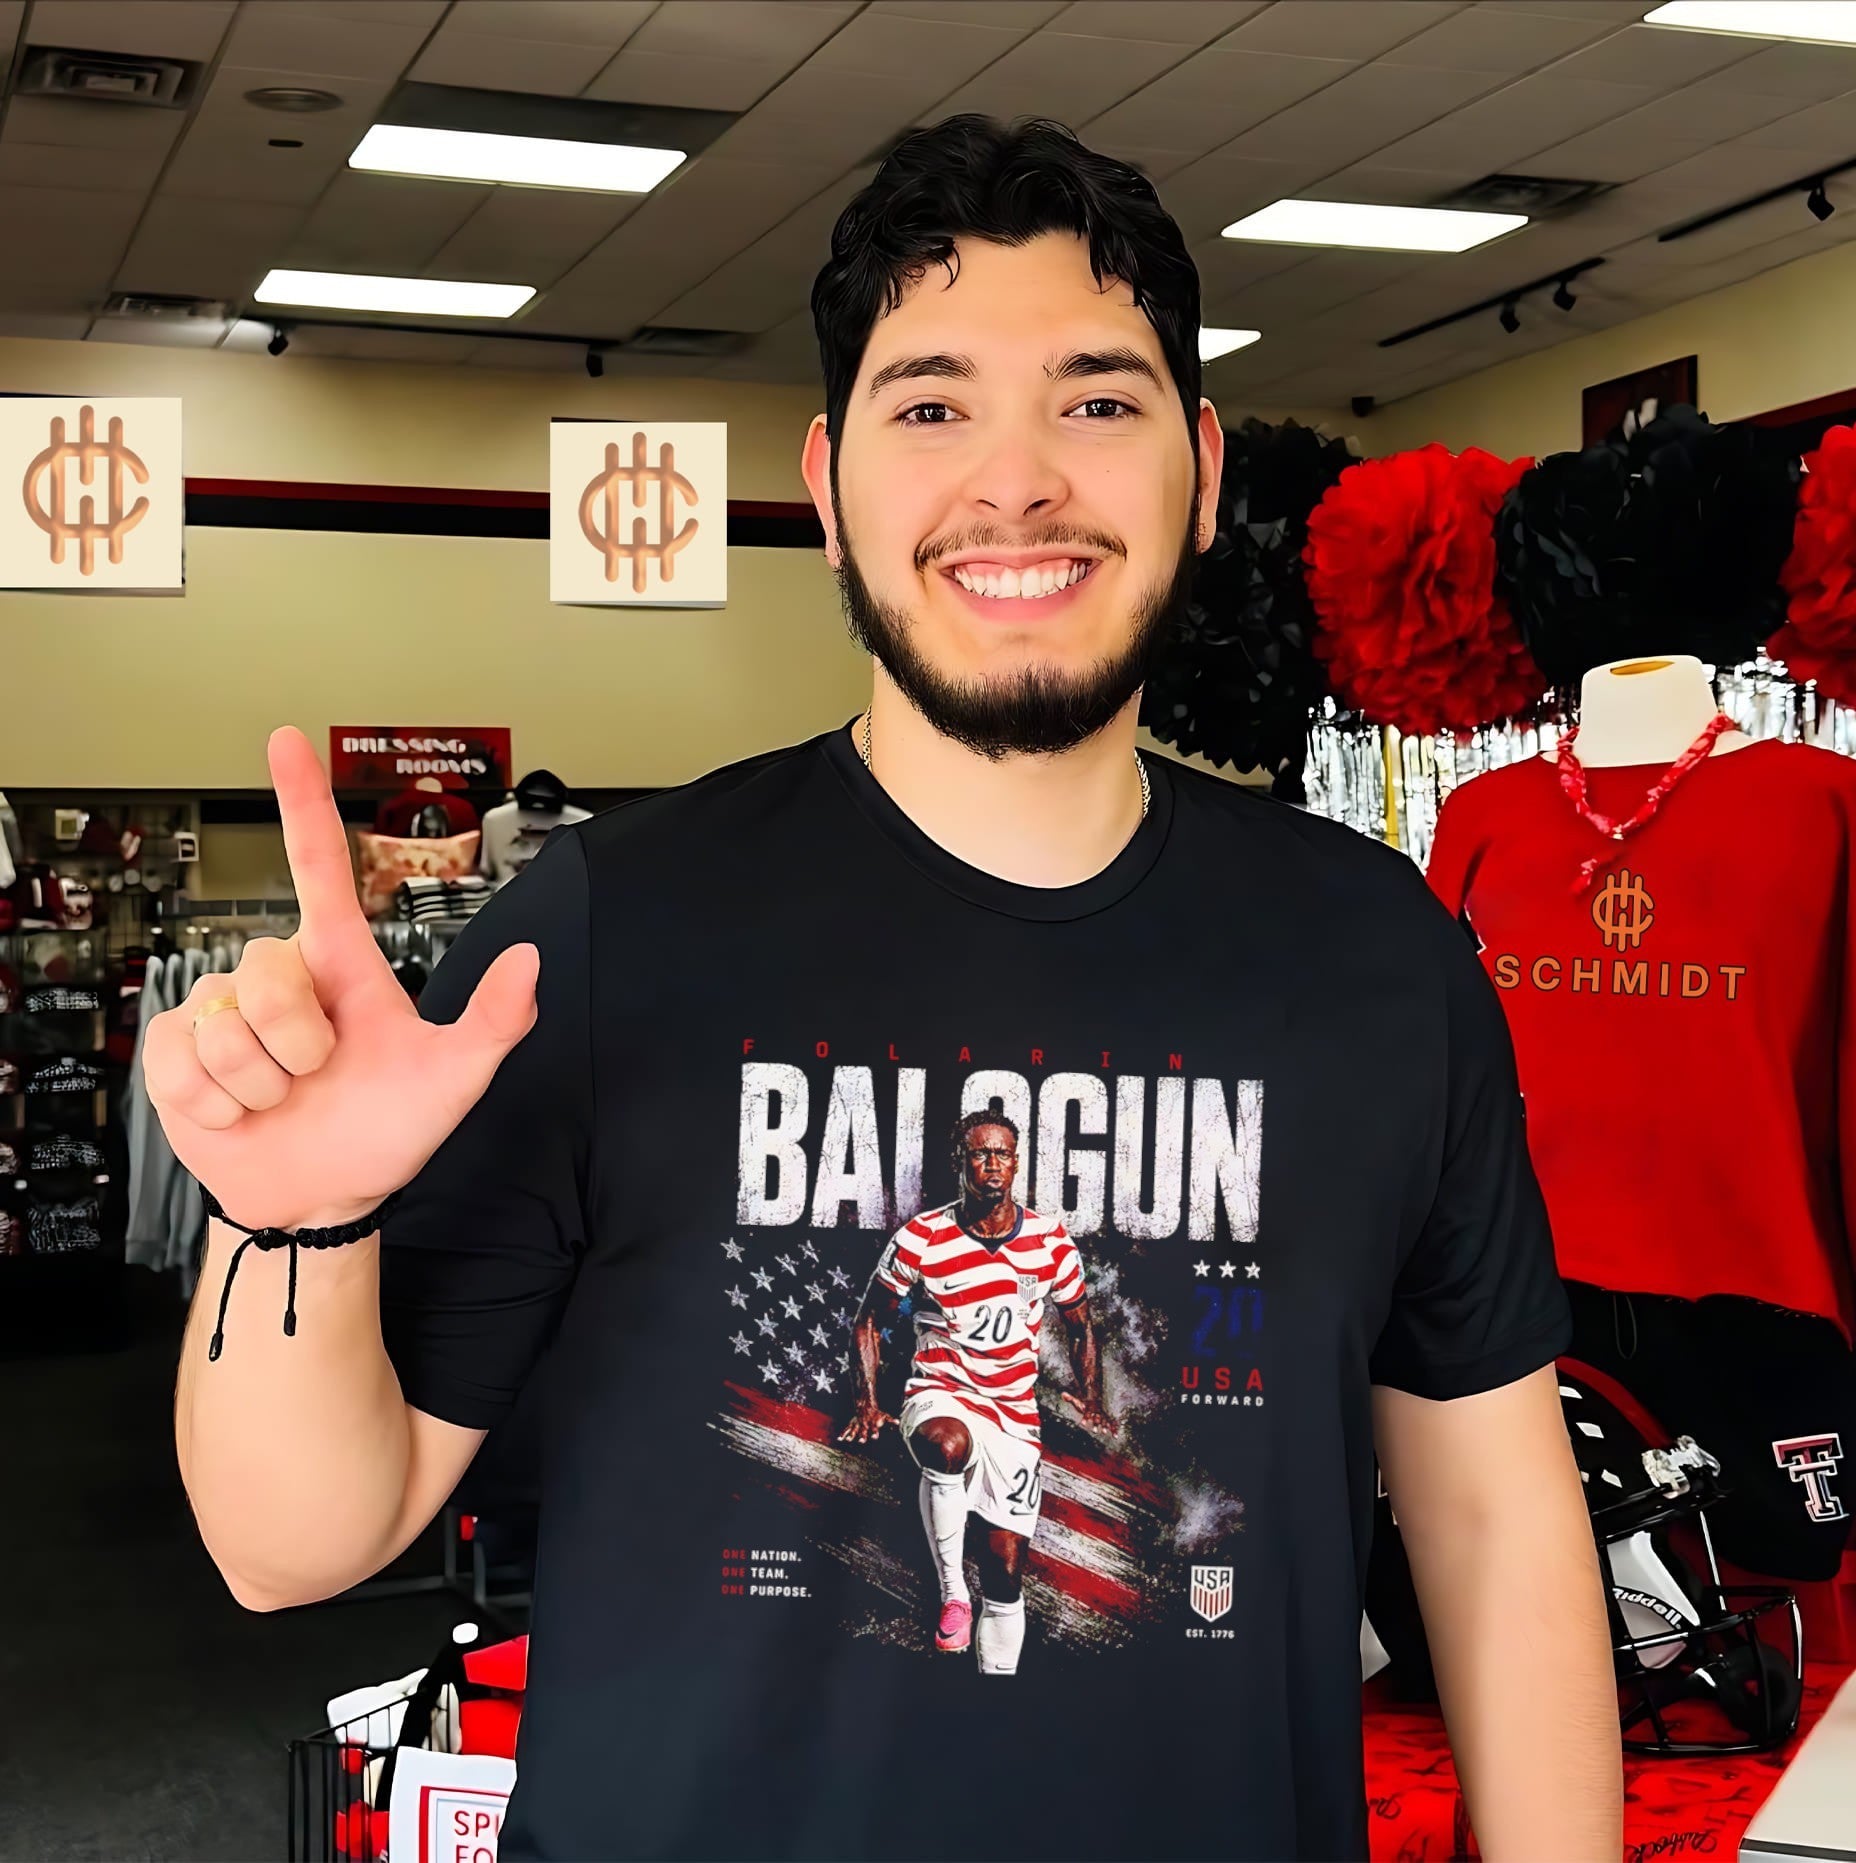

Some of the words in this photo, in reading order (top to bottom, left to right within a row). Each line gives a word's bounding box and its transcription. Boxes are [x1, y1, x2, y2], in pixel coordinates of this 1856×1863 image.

[342, 737, 467, 754] DRESSING
[1493, 953, 1747, 1001] SCHMIDT
[742, 1039, 1183, 1071] FOLARIN
[967, 1304, 1013, 1344] 20
[1180, 1366, 1263, 1391] USA
[1180, 1393, 1265, 1407] FORWARD
[1006, 1467, 1041, 1510] 20
[722, 1549, 746, 1560] ONE
[751, 1550, 802, 1562] NATION.
[722, 1566, 746, 1578] ONE
[751, 1566, 789, 1580] TEAM.
[1194, 1569, 1230, 1591] USA
[721, 1584, 744, 1595] ONE
[749, 1585, 812, 1598] PURPOSE.
[1185, 1628, 1208, 1639] EST.
[1211, 1629, 1236, 1640] 1776
